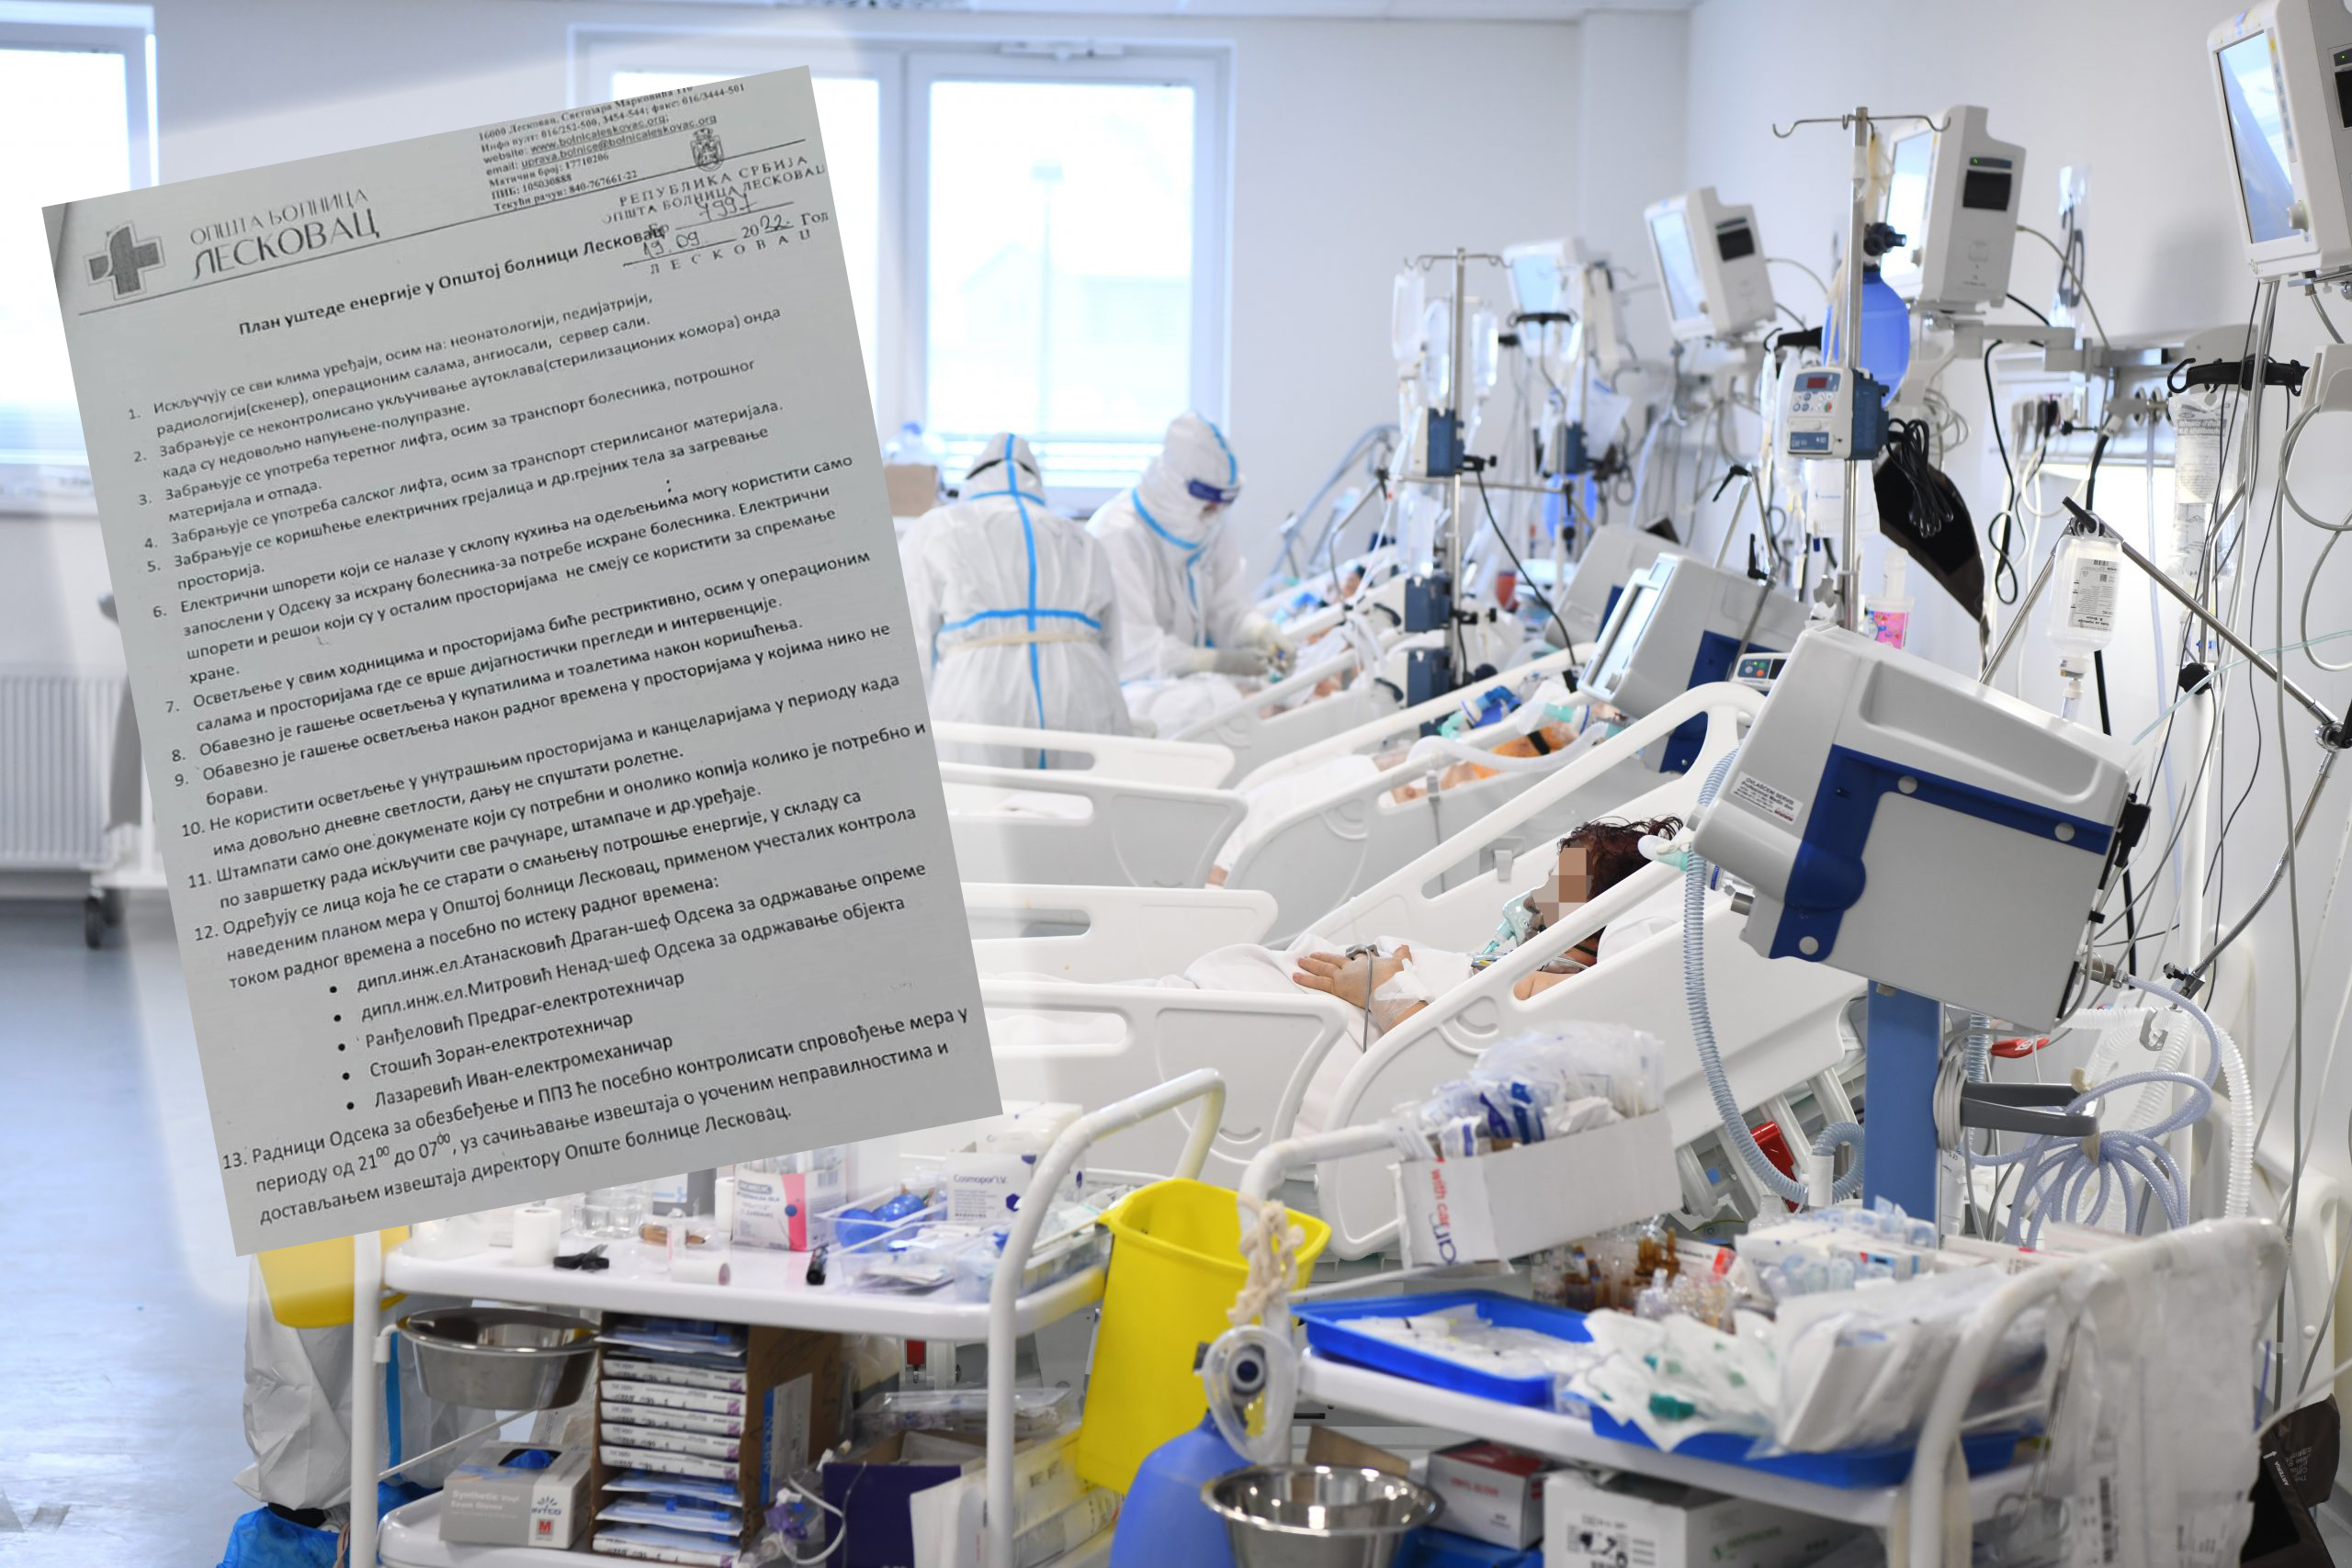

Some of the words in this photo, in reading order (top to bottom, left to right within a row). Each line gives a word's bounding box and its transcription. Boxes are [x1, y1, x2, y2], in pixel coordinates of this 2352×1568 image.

[482, 148, 524, 164] website:
[485, 161, 518, 176] email:
[521, 115, 718, 170] uprava.bolnice@bolnicaleskovac.org
[619, 173, 731, 207] РЕПУБЛИКА
[738, 156, 808, 178] СРБИЈА
[662, 186, 740, 210] БОЛНИЦА
[189, 215, 264, 244] ОПШТА
[194, 209, 380, 280] ЛЕСКОВАЦ
[239, 317, 280, 335] План
[284, 302, 345, 327] уштеде
[349, 284, 421, 310] енергије
[424, 281, 435, 295] у
[438, 263, 501, 288] Општој
[503, 247, 579, 274] болници
[582, 224, 665, 255] Лесковац
[128, 408, 141, 420] 1.
[153, 389, 227, 414] Искључују
[230, 385, 245, 397] се
[248, 379, 273, 392] сви
[275, 368, 321, 387] клима
[322, 355, 382, 378] уређаји,
[385, 345, 423, 362] осим
[424, 340, 447, 354] на:
[449, 313, 560, 347] неонатологији,
[561, 292, 652, 321] педијатрији,
[132, 450, 147, 463] 2.
[159, 430, 235, 457] Забрањује
[238, 427, 254, 439] се
[256, 400, 374, 434] неконтролисано
[376, 379, 467, 411] укључивање
[470, 333, 676, 389] аутоклава(стерилизационих
[678, 314, 741, 340] комора)
[742, 308, 781, 324] онда
[156, 389, 309, 438] радиологији(скенер),
[311, 370, 411, 400] операционим
[413, 357, 469, 378] салама,
[472, 339, 552, 365] ангиосали,
[559, 325, 609, 344] сервер
[612, 316, 650, 333] сали.
[143, 536, 158, 548] 4.
[170, 518, 249, 545] Забрањује
[252, 514, 268, 527] се
[270, 497, 338, 525] употреба
[340, 486, 395, 507] салског
[399, 476, 447, 495] лифта,
[449, 467, 489, 483] осим
[491, 462, 508, 475] за
[509, 444, 586, 471] транспорт
[589, 421, 688, 453] стерилисаног
[693, 401, 783, 429] материјала.
[182, 610, 264, 637] запослени
[266, 608, 275, 622] у
[277, 595, 332, 616] Одсеку
[334, 592, 351, 604] за
[354, 578, 413, 600] исхрану
[416, 556, 517, 587] болесника-за
[519, 540, 582, 565] потребе
[585, 527, 647, 550] исхране
[650, 508, 736, 536] болесника.
[738, 486, 830, 515] Електрични
[171, 748, 186, 762] 8.
[198, 730, 276, 756] Обавезно
[277, 726, 292, 742] је
[295, 713, 356, 735] гашење
[358, 694, 446, 721] осветљења
[447, 691, 458, 705] у
[460, 671, 551, 701] купатилима
[554, 669, 565, 680] и
[567, 650, 650, 677] тоалетима
[653, 639, 701, 659] након
[703, 618, 803, 649] коришћења.
[226, 931, 318, 962] наведеним
[321, 919, 382, 942] планом
[385, 908, 426, 928] мера
[428, 906, 438, 921] у
[441, 888, 501, 915] Општој
[503, 877, 574, 902] болници
[578, 860, 661, 887] Лесковац,
[663, 841, 752, 871] применом
[752, 824, 835, 854] учесталих
[837, 807, 917, 834] контрола
[356, 933, 567, 994] дипл.инж.ел.Атанасковић
[570, 912, 671, 950] Драган-шеф
[673, 902, 734, 926] Одсека
[737, 898, 756, 912] за
[759, 877, 858, 909] одржавање
[860, 863, 926, 887] опреме
[369, 1051, 433, 1077] Стошић
[435, 1012, 633, 1065] Зоран-електротехничар
[374, 1075, 463, 1108] Лазаревић
[465, 1035, 673, 1089] Иван-електромеханичар
[259, 1187, 380, 1226] достављањем
[383, 1167, 467, 1197] извештаја
[470, 1150, 560, 1183] директору
[564, 1137, 621, 1160] Опште
[625, 1122, 700, 1148] болнице
[704, 1105, 792, 1134] Лесковац.
